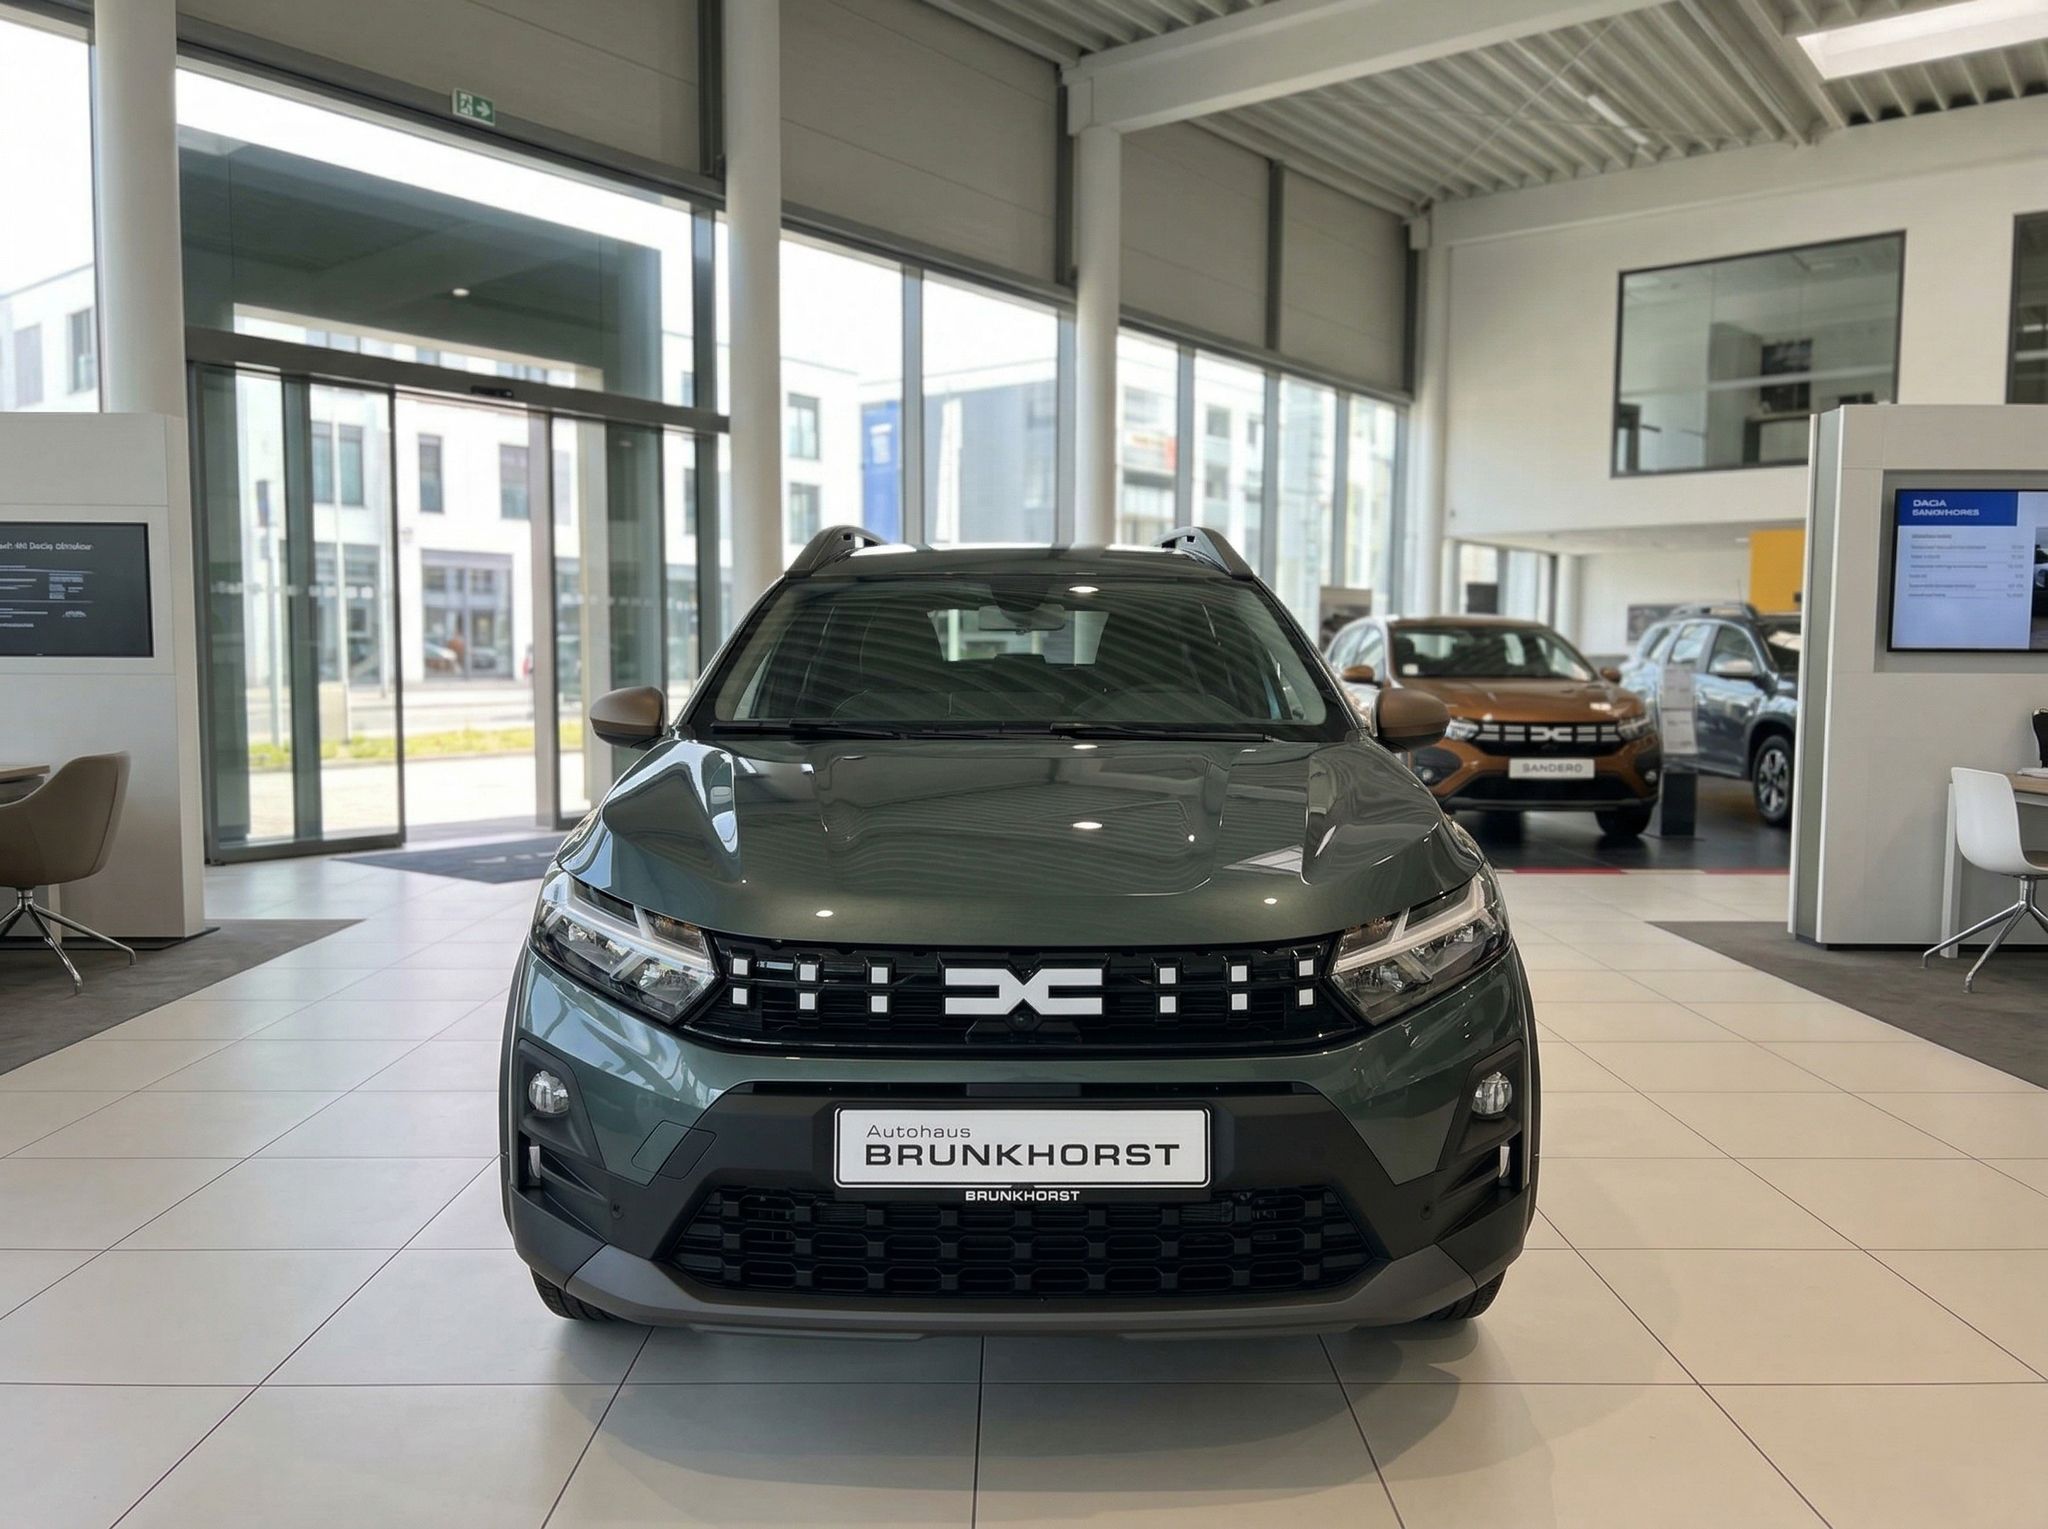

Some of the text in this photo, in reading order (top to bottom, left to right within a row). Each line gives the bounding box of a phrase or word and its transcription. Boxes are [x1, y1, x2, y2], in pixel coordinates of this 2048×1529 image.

[1522, 763, 1584, 773] SANDERO
[866, 1124, 971, 1139] Autohaus
[865, 1143, 1180, 1166] BRUNKHORST
[965, 1190, 1081, 1202] BRUNKHORST
